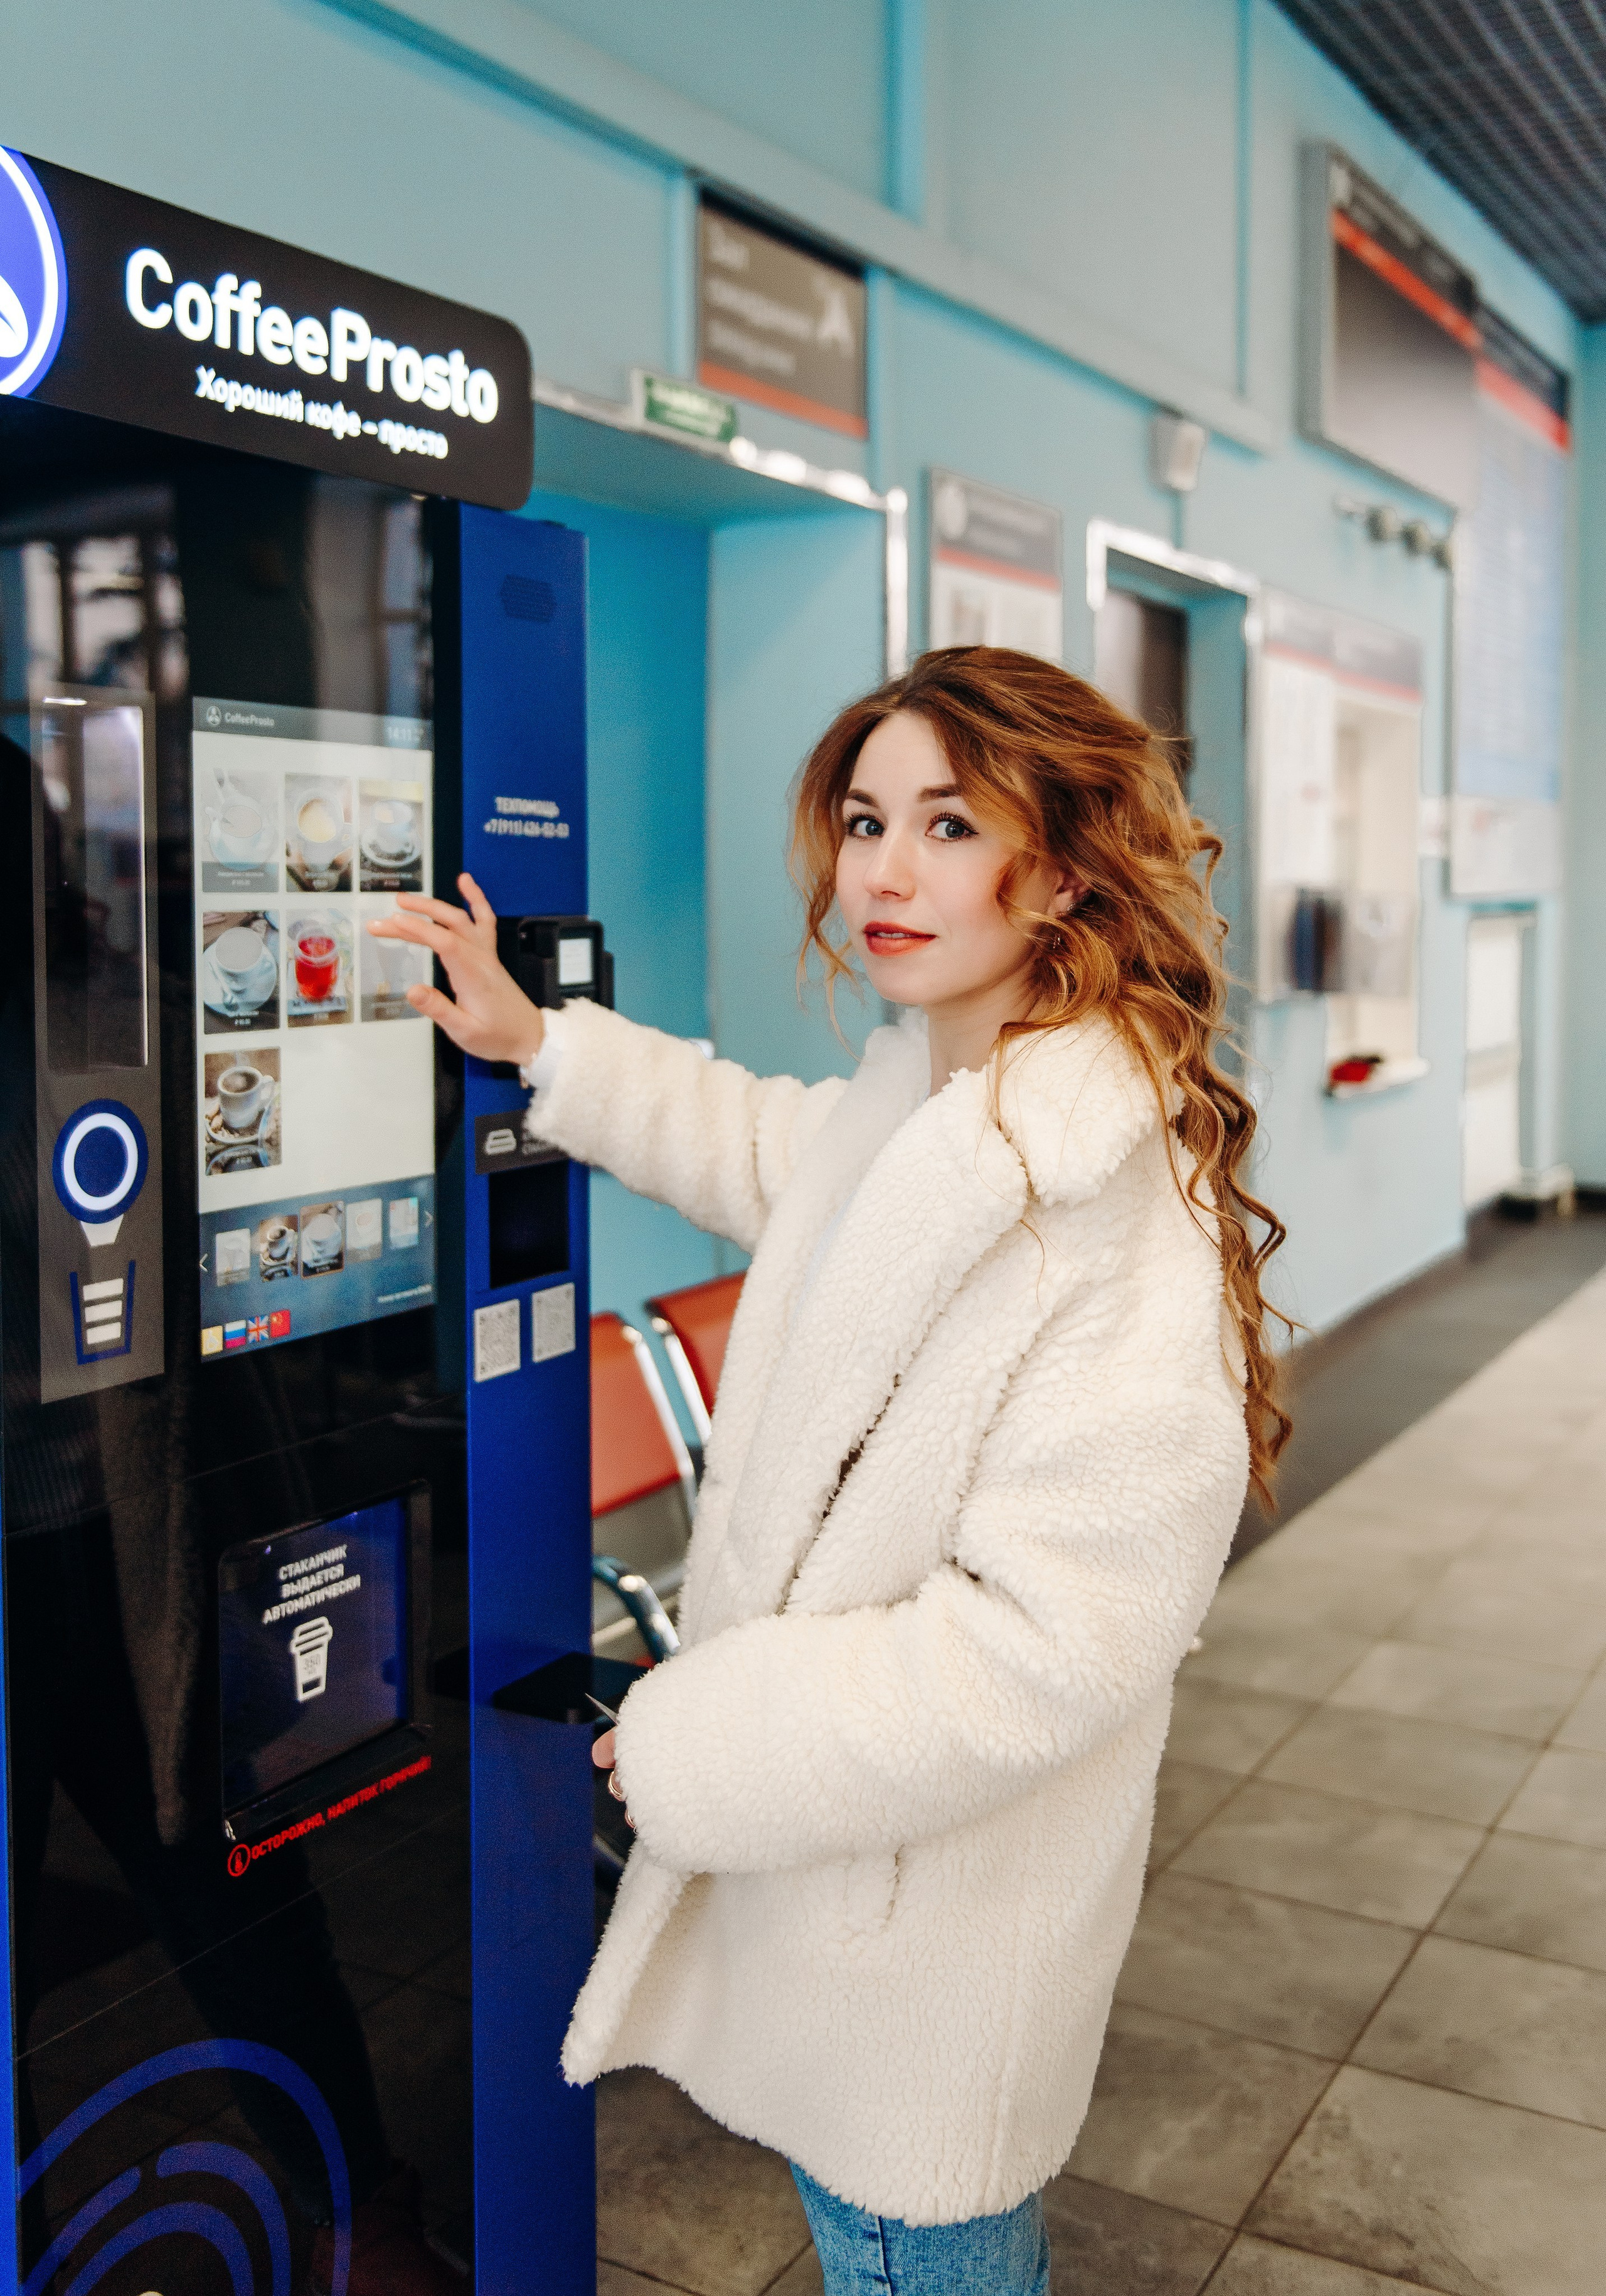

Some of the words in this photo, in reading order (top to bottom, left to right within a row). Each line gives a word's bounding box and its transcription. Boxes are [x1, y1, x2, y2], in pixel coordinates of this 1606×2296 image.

[125, 248, 499, 423] CoffeeProsto
[196, 366, 304, 422] Хороший
[305, 401, 361, 440] кофе
[378, 419, 449, 459] просто
[279, 1544, 348, 1580] СТАКАНЧИК
[281, 1563, 344, 1599] ВЫДАЕТСЯ
[262, 1574, 361, 1625] АВТОМАТИЧЕСКИ
